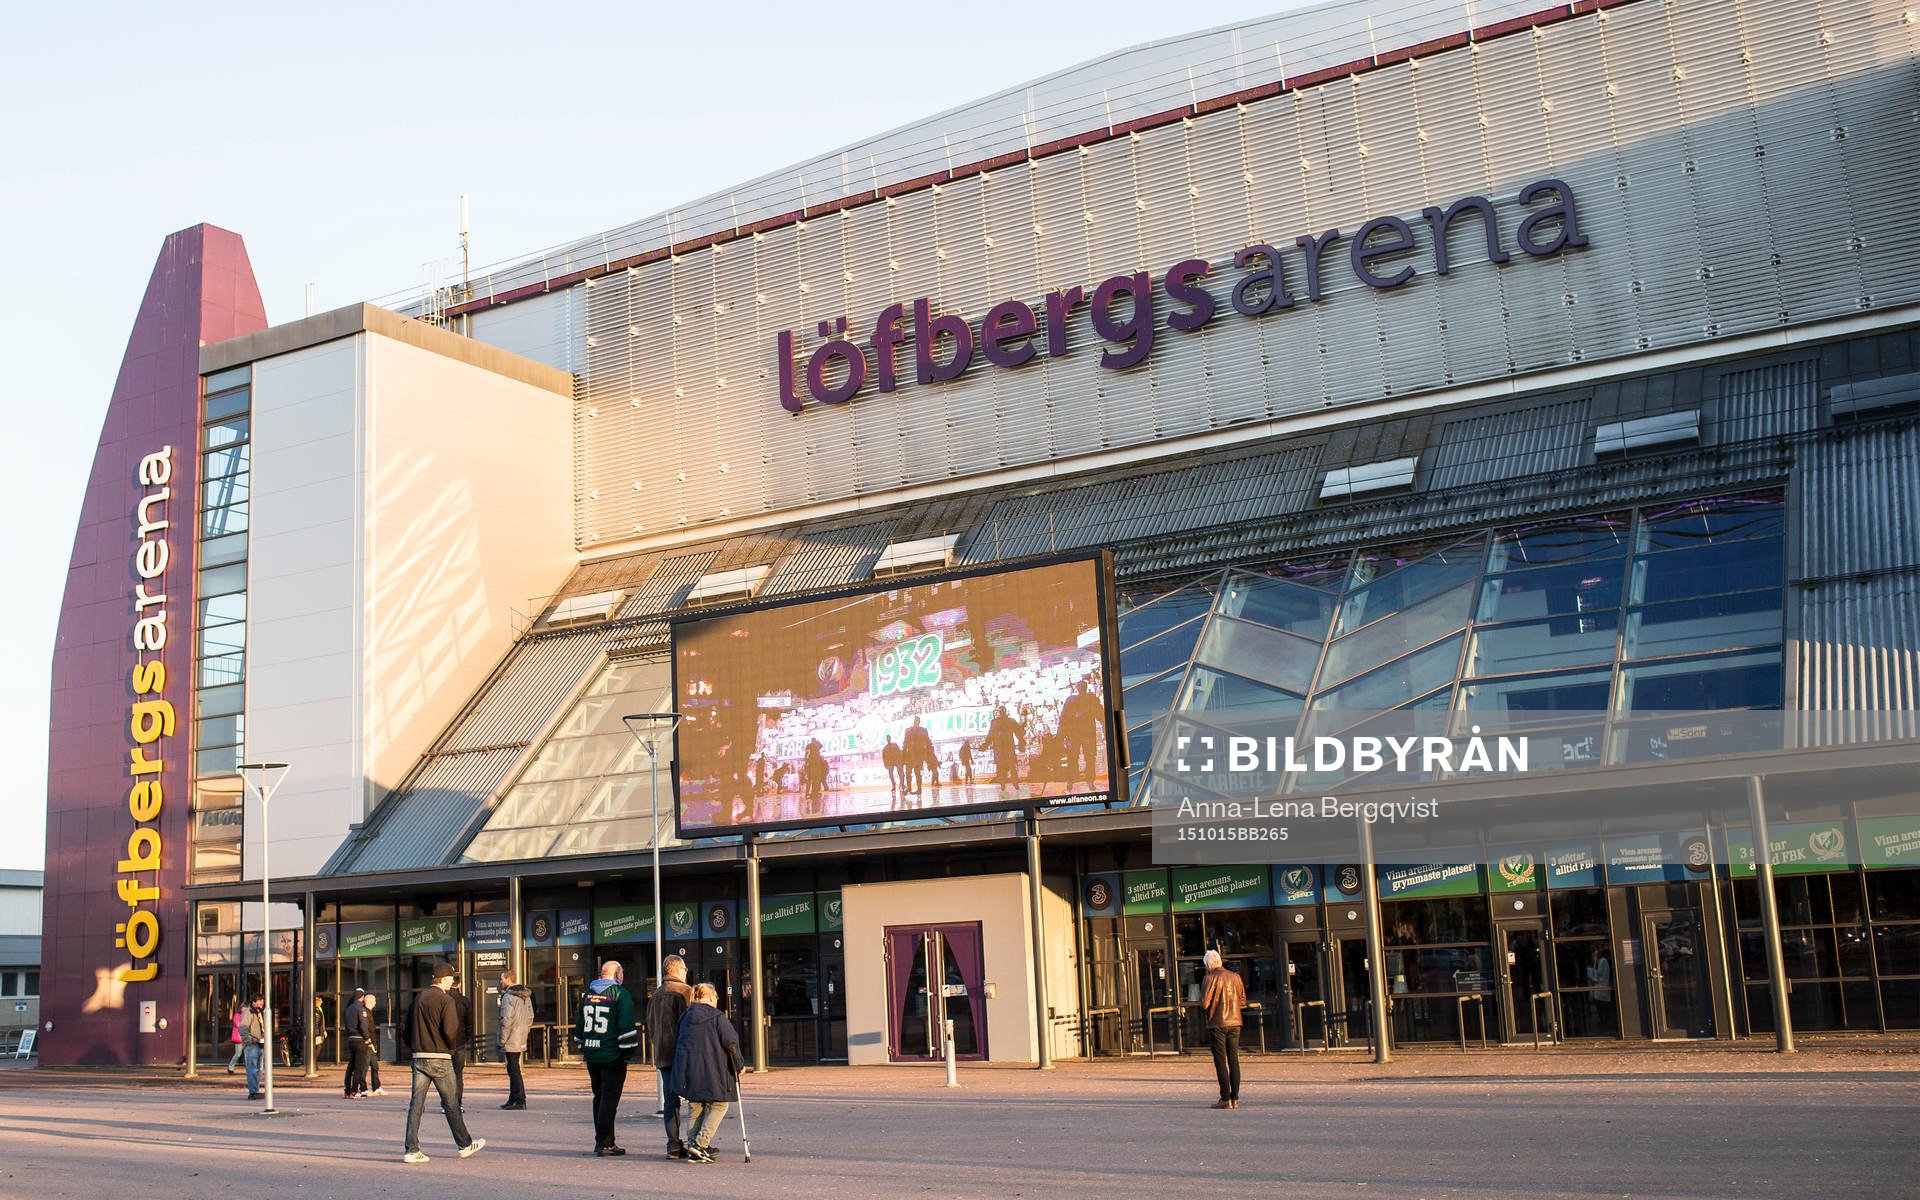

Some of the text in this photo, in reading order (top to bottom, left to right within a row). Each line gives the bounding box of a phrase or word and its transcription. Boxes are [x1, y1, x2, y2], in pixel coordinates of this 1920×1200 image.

[778, 178, 1591, 413] löfbergsarena
[866, 631, 943, 700] 1932
[115, 444, 175, 983] löfbergsarena
[1874, 835, 1899, 846] Vinn
[1551, 852, 1586, 867] 3 stöttar
[1620, 847, 1636, 855] Vinn
[1688, 842, 1708, 866] 3
[1739, 847, 1747, 859] 3
[1782, 848, 1807, 864] FBK
[1341, 867, 1358, 889] 3
[1386, 861, 1443, 881] Vinn arenans
[1392, 861, 1477, 891] grymmaste platser!
[1555, 863, 1579, 876] alltid
[1127, 881, 1156, 895] 3 stöttar
[1179, 875, 1231, 894] Vinn arenans
[1184, 875, 1261, 904] grymmaste platser!
[1091, 884, 1106, 905] 3
[1131, 888, 1165, 903] alltid FBK
[713, 909, 725, 928] 3
[774, 903, 794, 919] alltid
[795, 901, 810, 913] FBK
[477, 952, 506, 960] PERSONAL
[583, 1005, 610, 1034] 65
